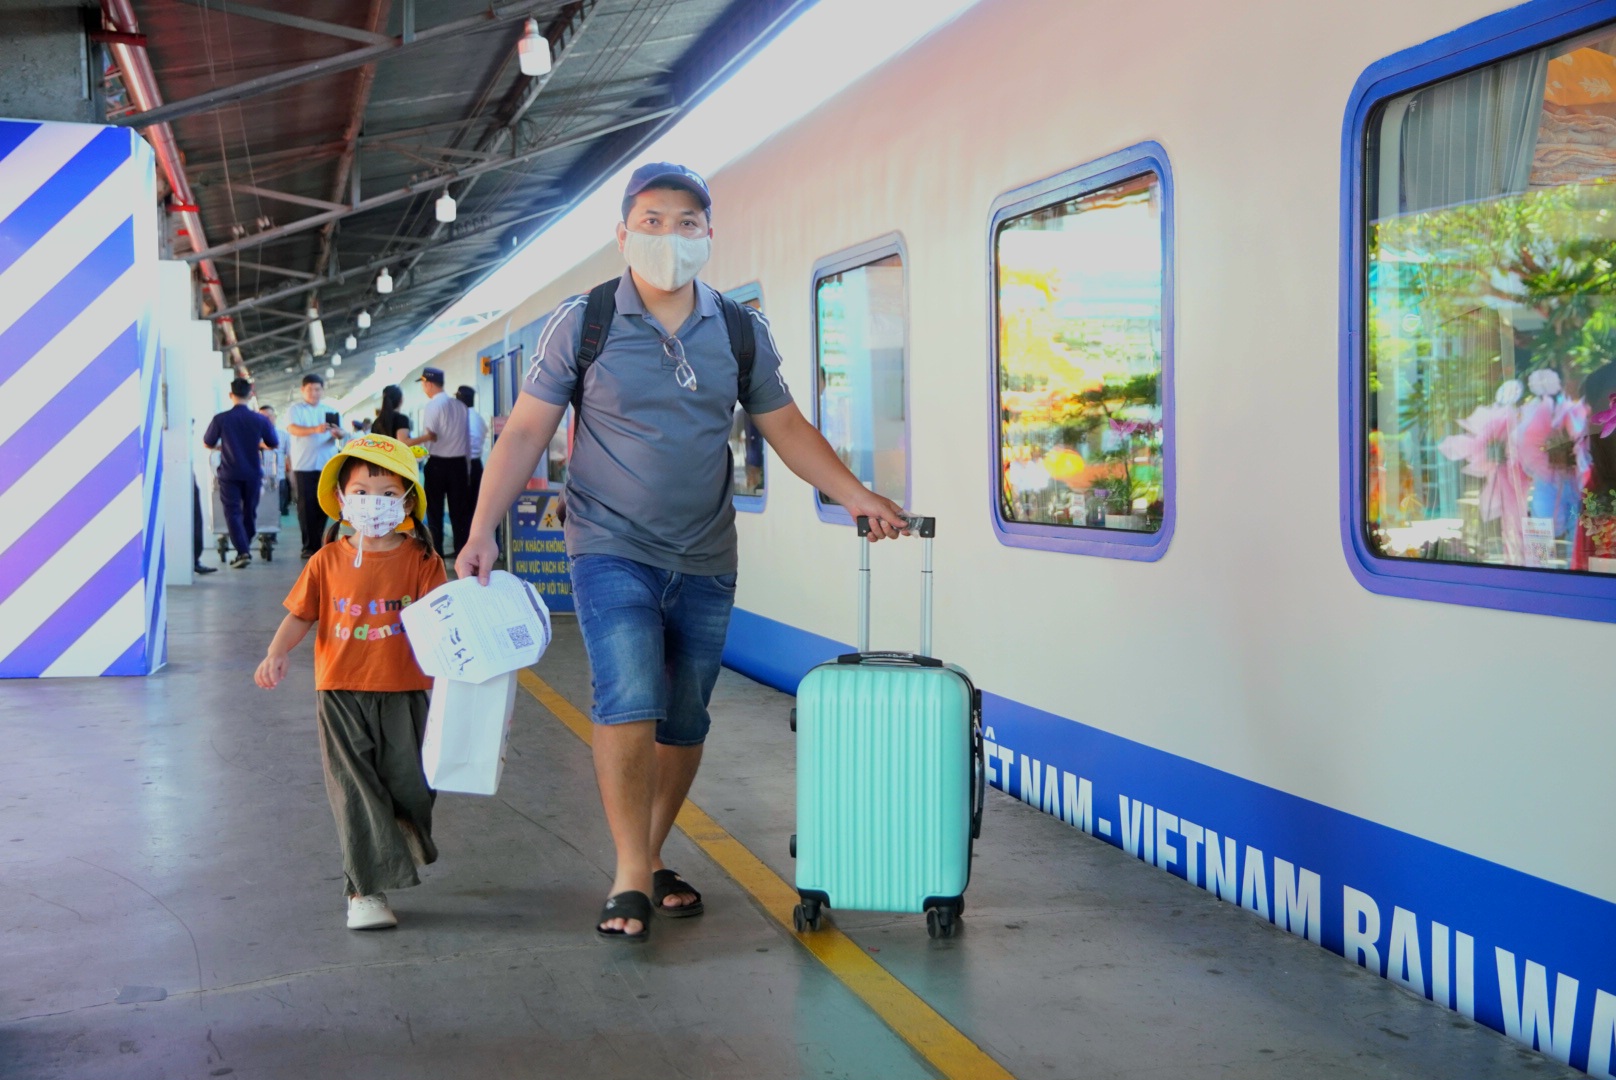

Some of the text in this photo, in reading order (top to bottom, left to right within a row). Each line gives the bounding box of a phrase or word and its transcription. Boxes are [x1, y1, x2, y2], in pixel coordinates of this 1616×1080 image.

[525, 537, 545, 552] KHÁCH
[545, 537, 566, 553] KHÔNG
[516, 560, 528, 573] KHU
[333, 595, 412, 617] it's time
[335, 622, 351, 640] to
[1020, 754, 1093, 836] NAM
[1118, 794, 1322, 947] VIETNAM
